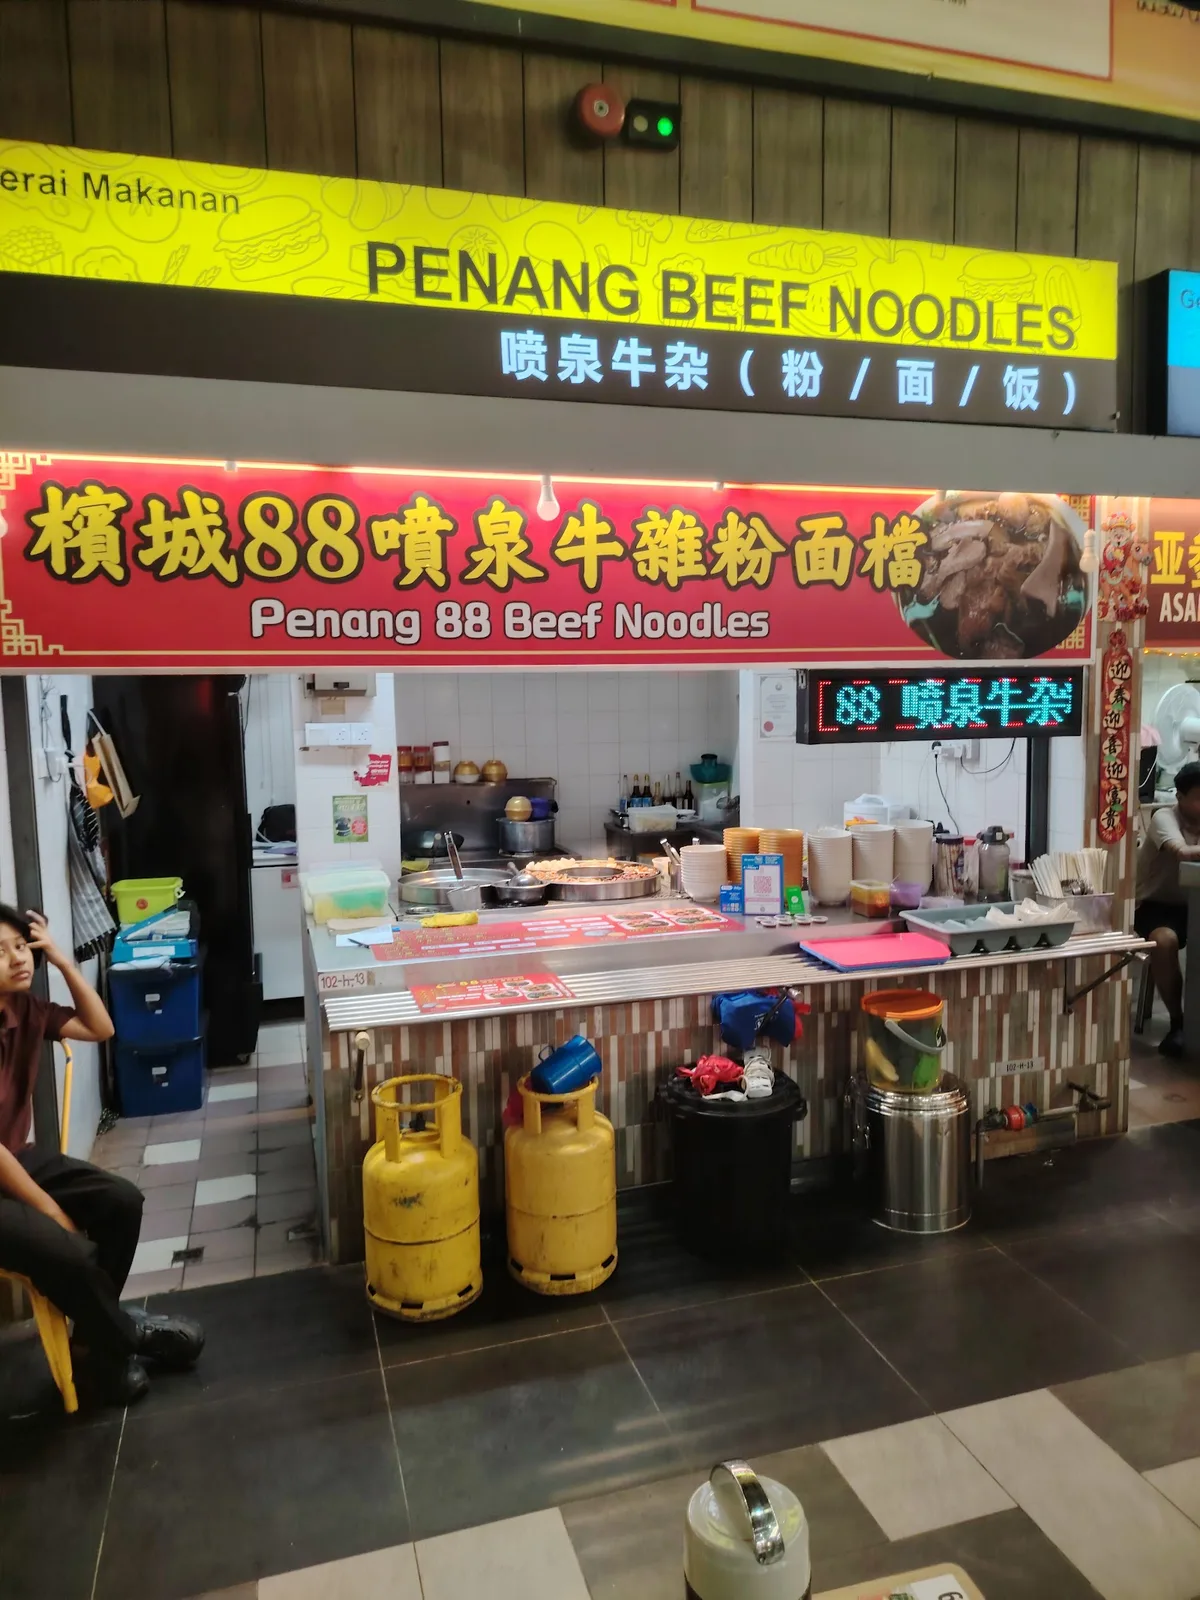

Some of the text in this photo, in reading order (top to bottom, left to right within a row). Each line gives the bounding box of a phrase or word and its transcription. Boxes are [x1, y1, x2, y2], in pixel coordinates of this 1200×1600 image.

[83, 171, 240, 214] Makanan
[367, 240, 1077, 351] PENANG BEEF NOODLES
[250, 598, 770, 645] Penang 88 Beef Noodles
[835, 686, 881, 726] 88
